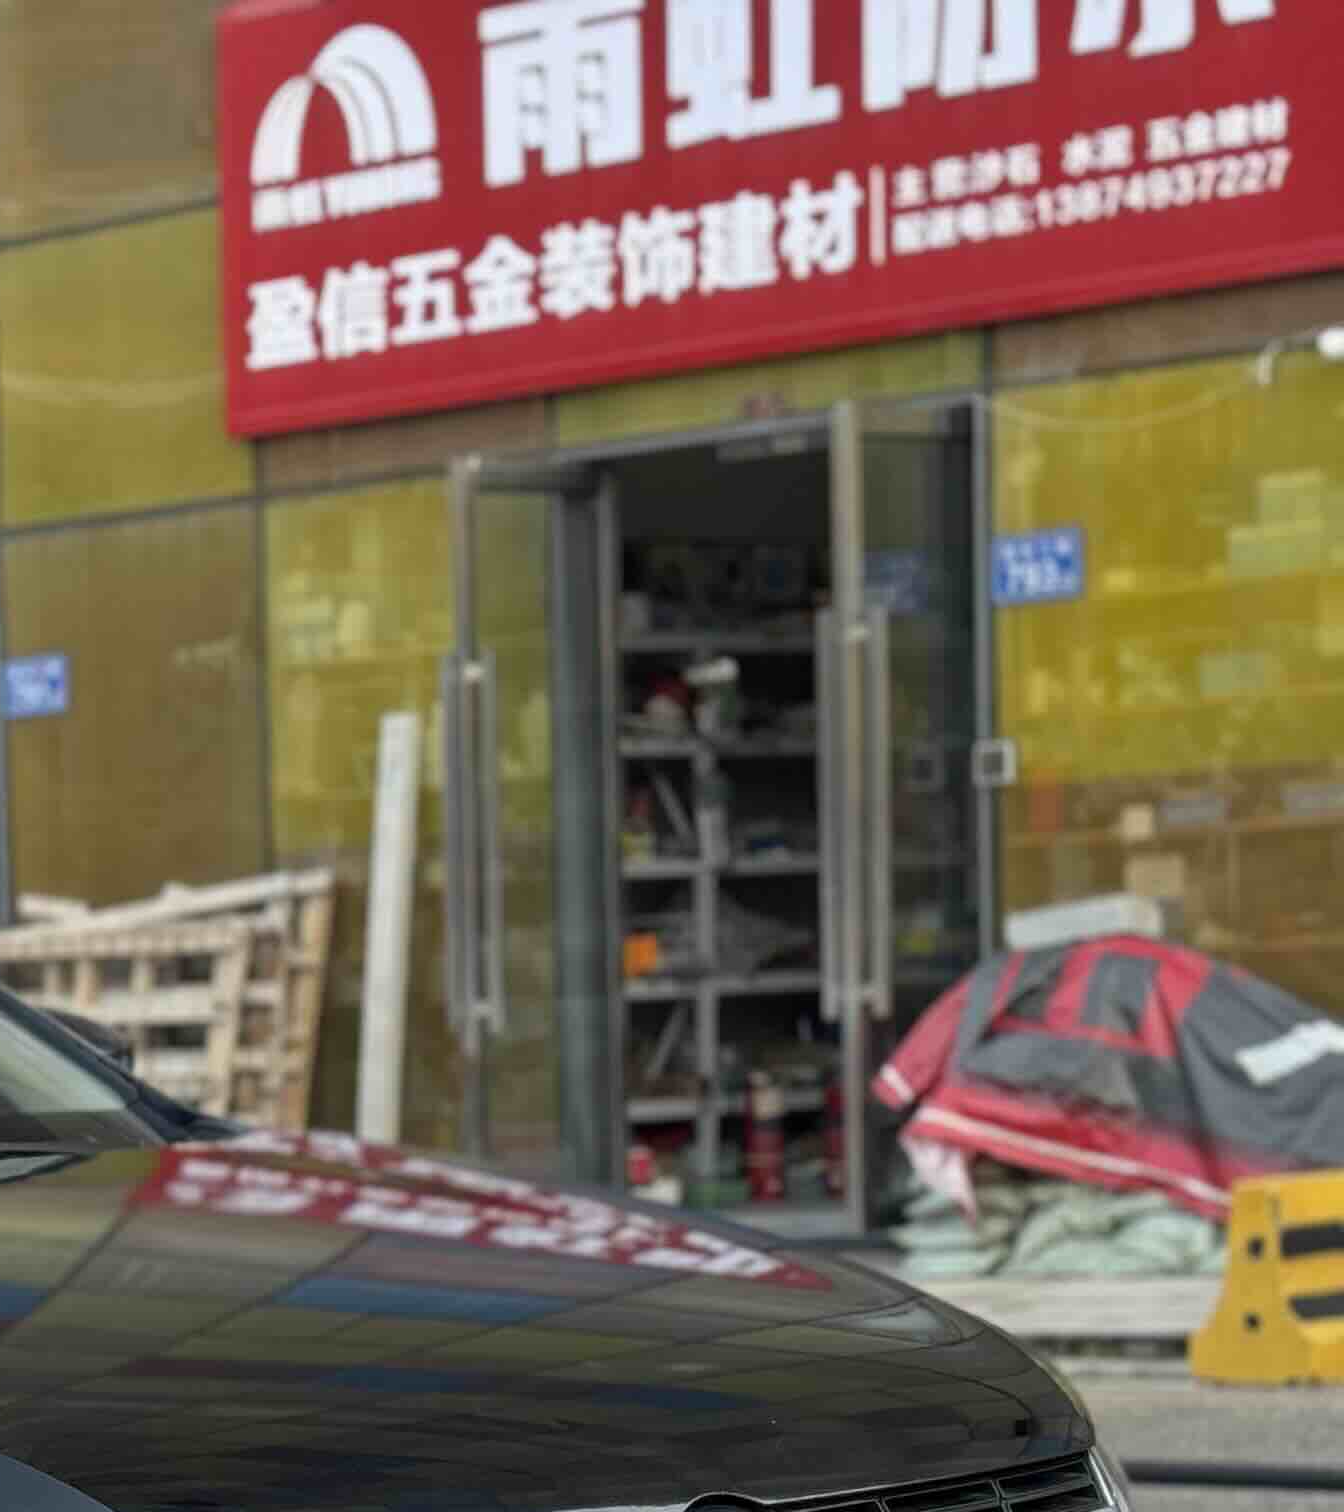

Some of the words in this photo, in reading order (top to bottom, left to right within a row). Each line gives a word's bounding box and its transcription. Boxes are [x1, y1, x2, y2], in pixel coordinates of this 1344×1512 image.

[244, 168, 864, 372] 盈信五金装饰建材
